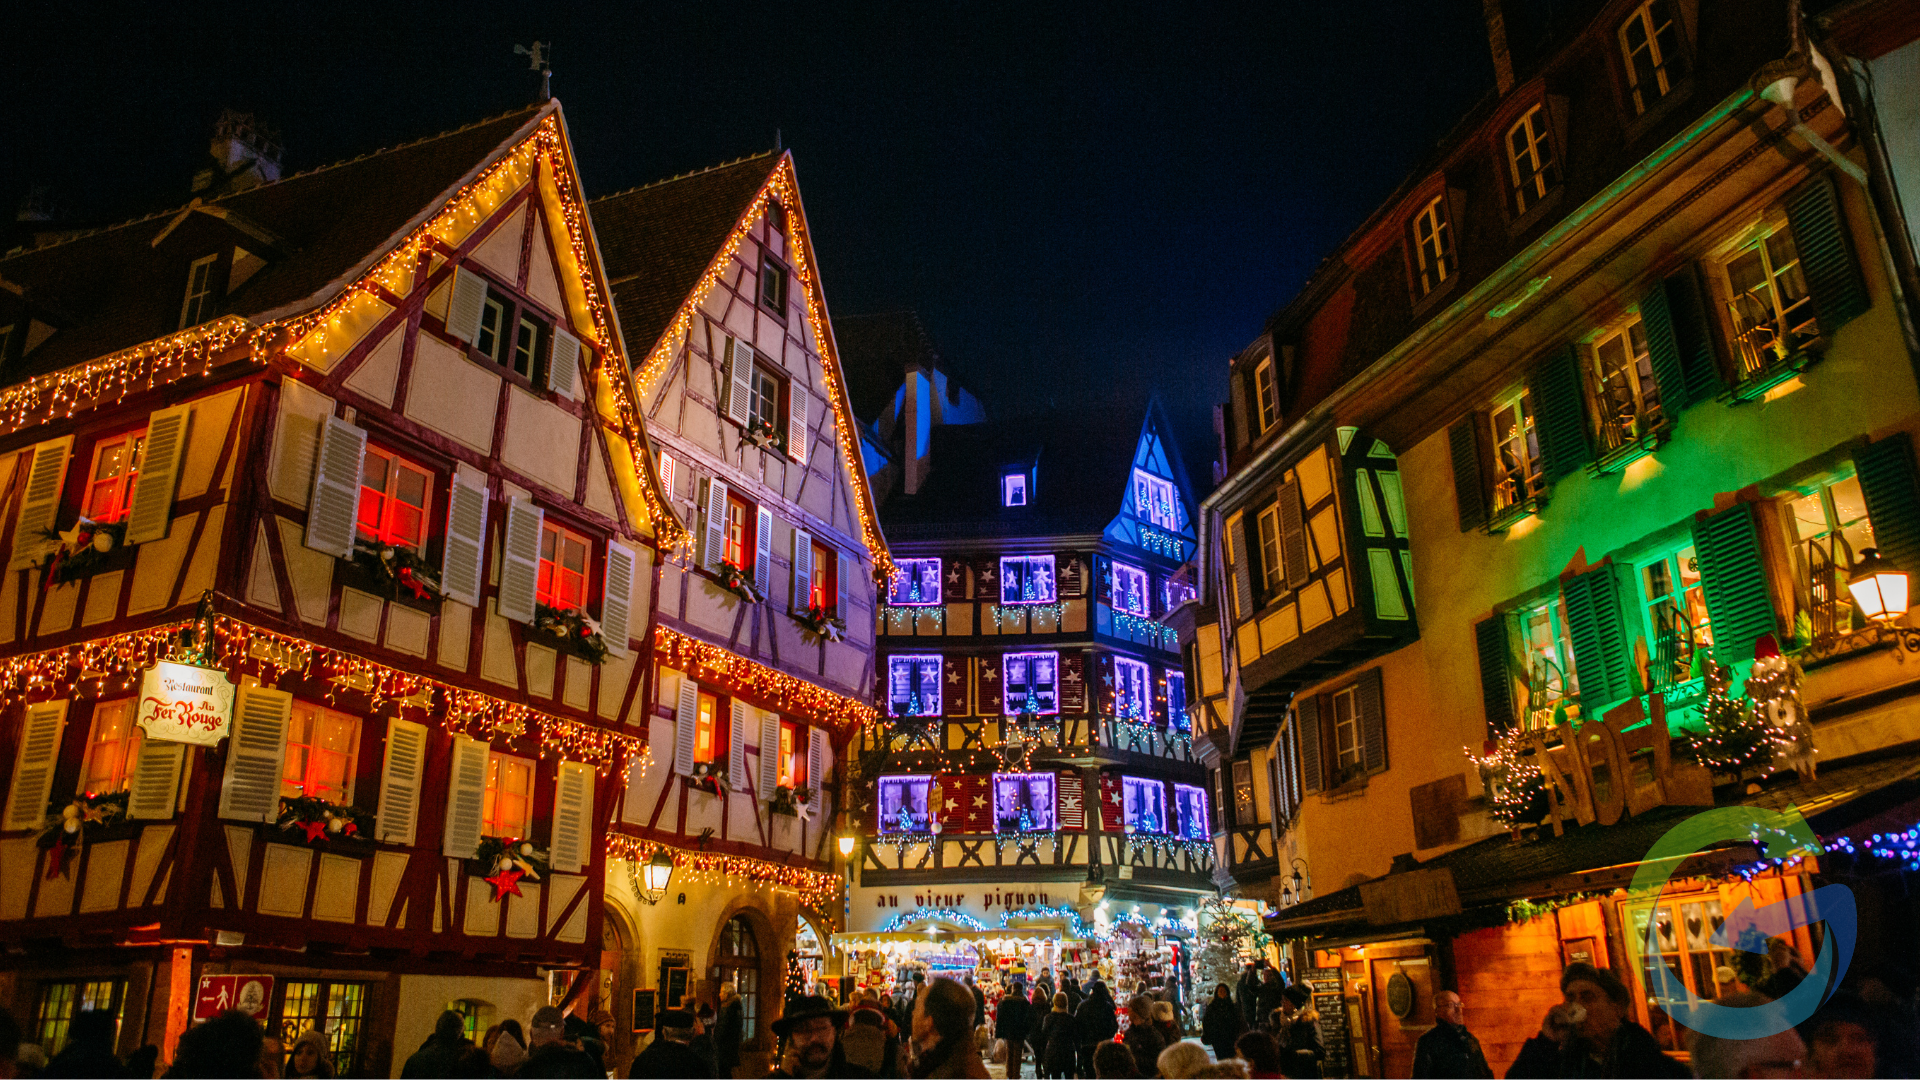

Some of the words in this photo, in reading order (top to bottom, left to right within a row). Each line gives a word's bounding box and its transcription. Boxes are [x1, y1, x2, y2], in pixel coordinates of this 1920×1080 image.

[163, 677, 214, 696] Restaurant
[143, 696, 177, 725] Fer
[175, 700, 223, 732] Rouge
[198, 701, 215, 712] Au
[877, 894, 899, 908] au
[915, 889, 965, 907] vieux
[983, 887, 1049, 912] pignon
